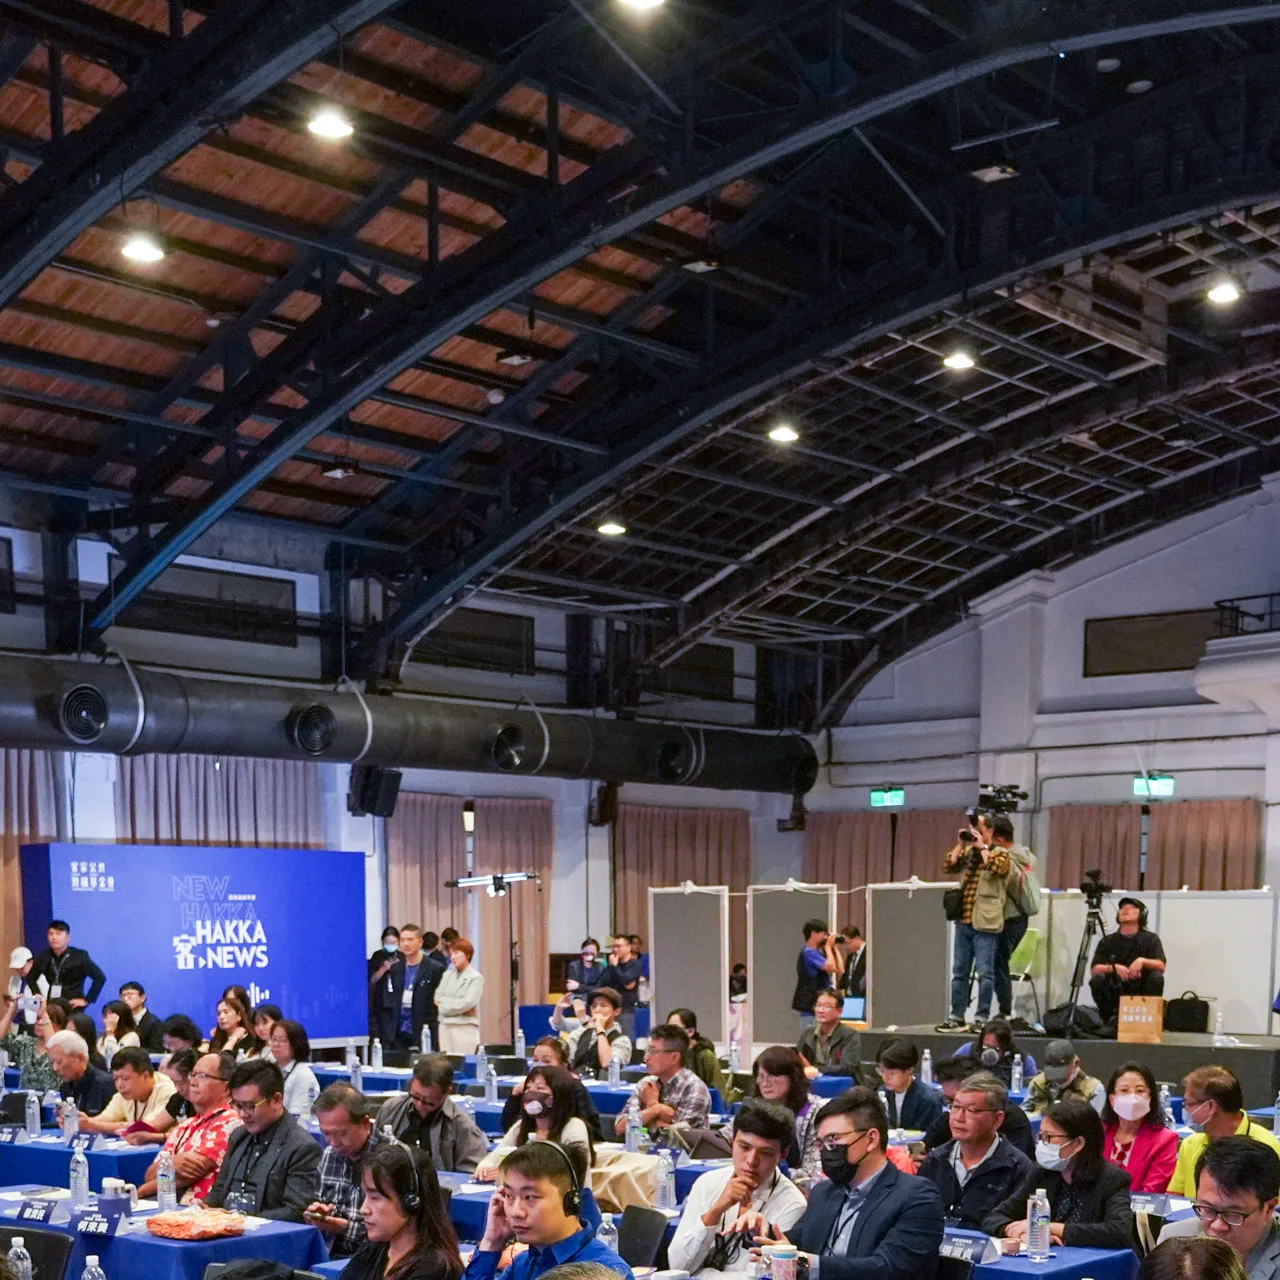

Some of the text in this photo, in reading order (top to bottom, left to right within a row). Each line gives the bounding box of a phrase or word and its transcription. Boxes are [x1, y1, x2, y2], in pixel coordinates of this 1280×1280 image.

[172, 875, 229, 900] NEW
[196, 920, 267, 944] HAKKA
[207, 946, 269, 968] NEWS
